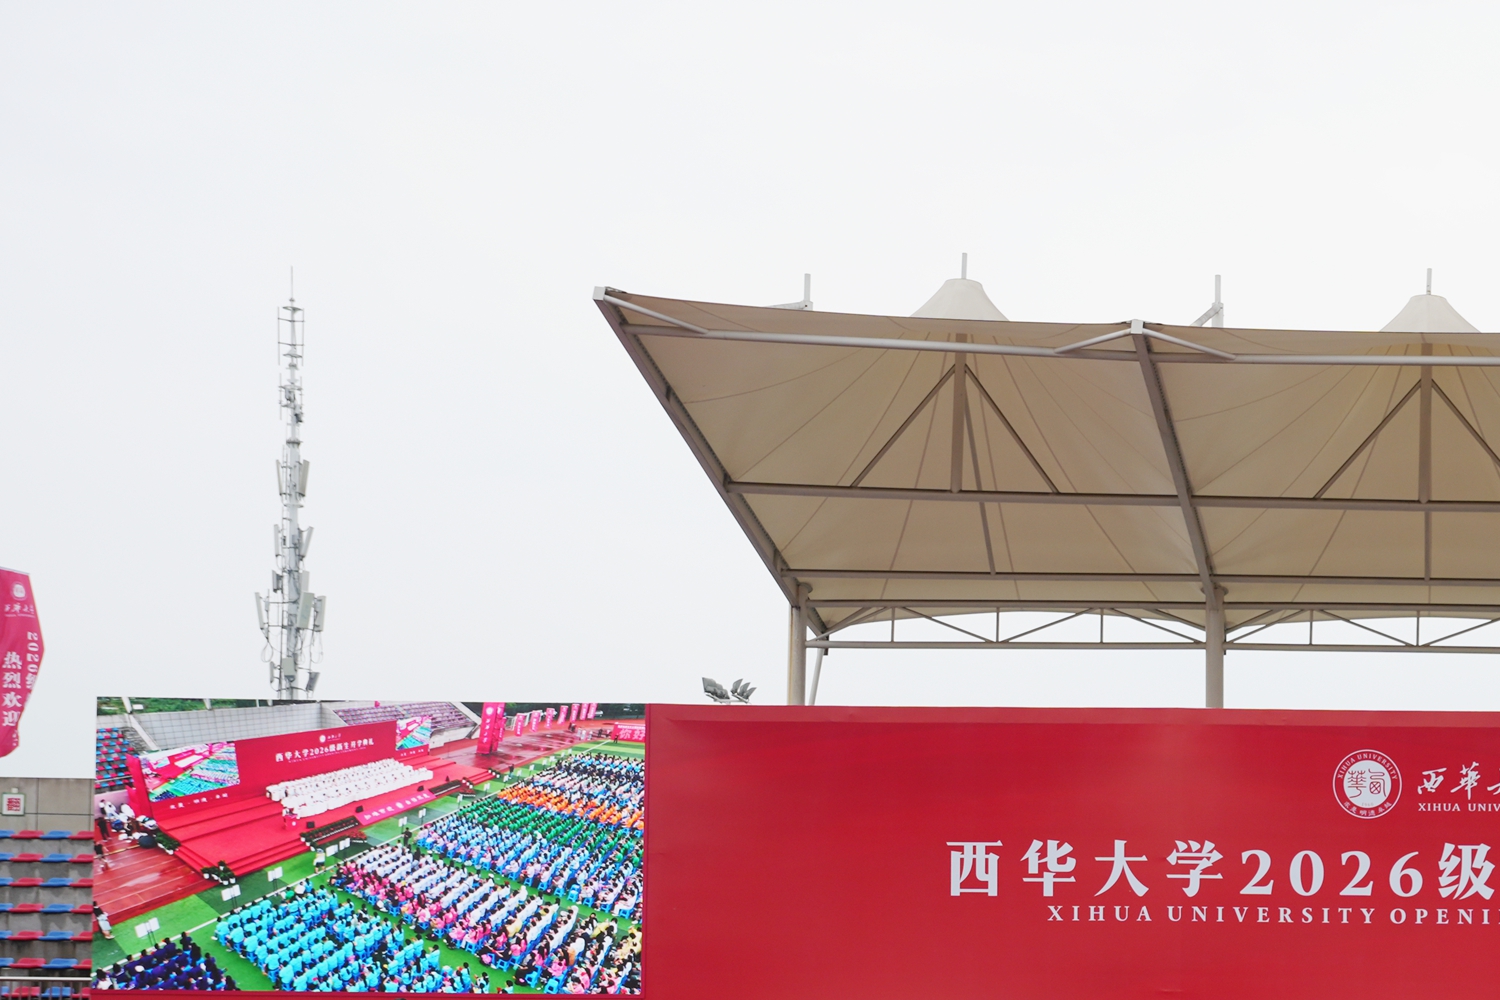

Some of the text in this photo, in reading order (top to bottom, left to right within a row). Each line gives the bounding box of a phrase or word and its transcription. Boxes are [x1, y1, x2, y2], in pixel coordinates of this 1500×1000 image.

[2, 651, 23, 727] 热烈欢迎
[1418, 802, 1461, 812] XIHUA
[1047, 905, 1152, 921] XIHUA
[1166, 905, 1375, 923] UNIVERSITY
